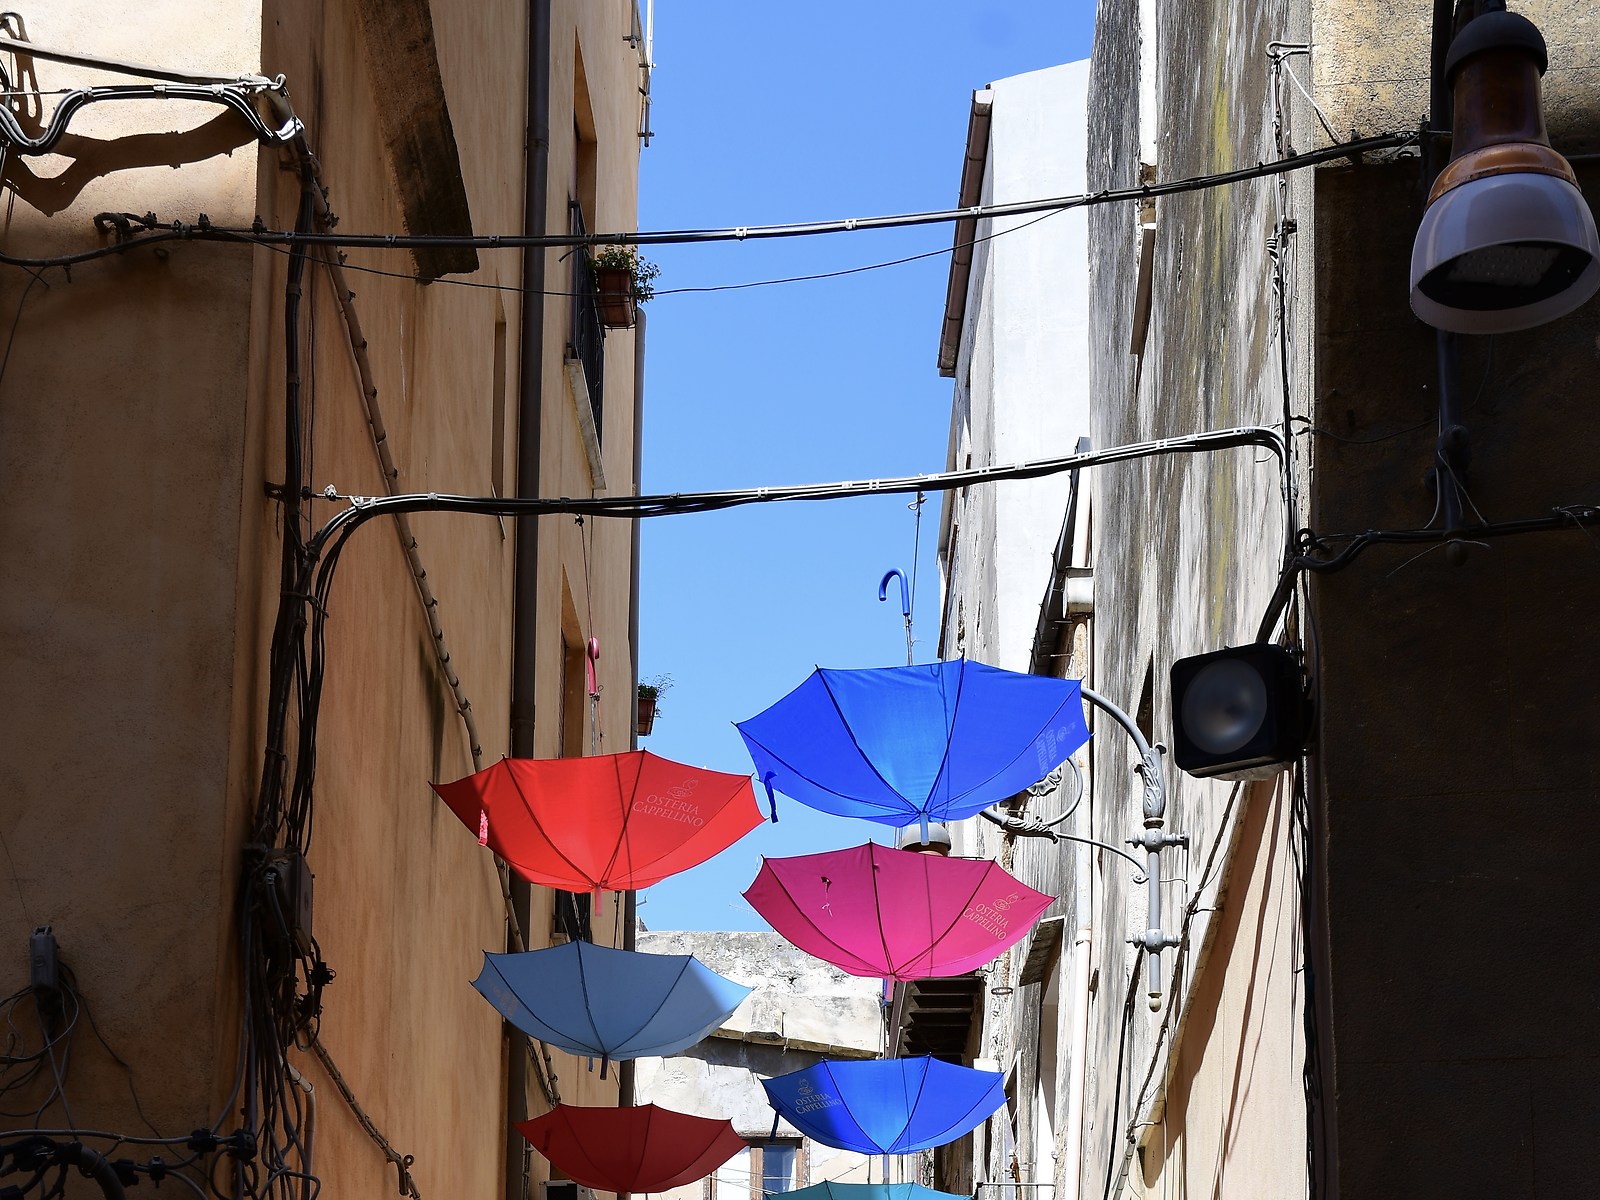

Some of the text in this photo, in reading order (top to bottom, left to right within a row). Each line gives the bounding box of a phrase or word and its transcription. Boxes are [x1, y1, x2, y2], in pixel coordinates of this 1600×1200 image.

[632, 801, 704, 827] CAPPELLINO
[646, 794, 699, 815] OSTERIA
[962, 907, 1007, 940] CAPPELLINO
[975, 903, 1009, 929] OSTERIA
[795, 1093, 832, 1106] OSTERIA
[795, 1099, 843, 1114] CAPPELLINO
